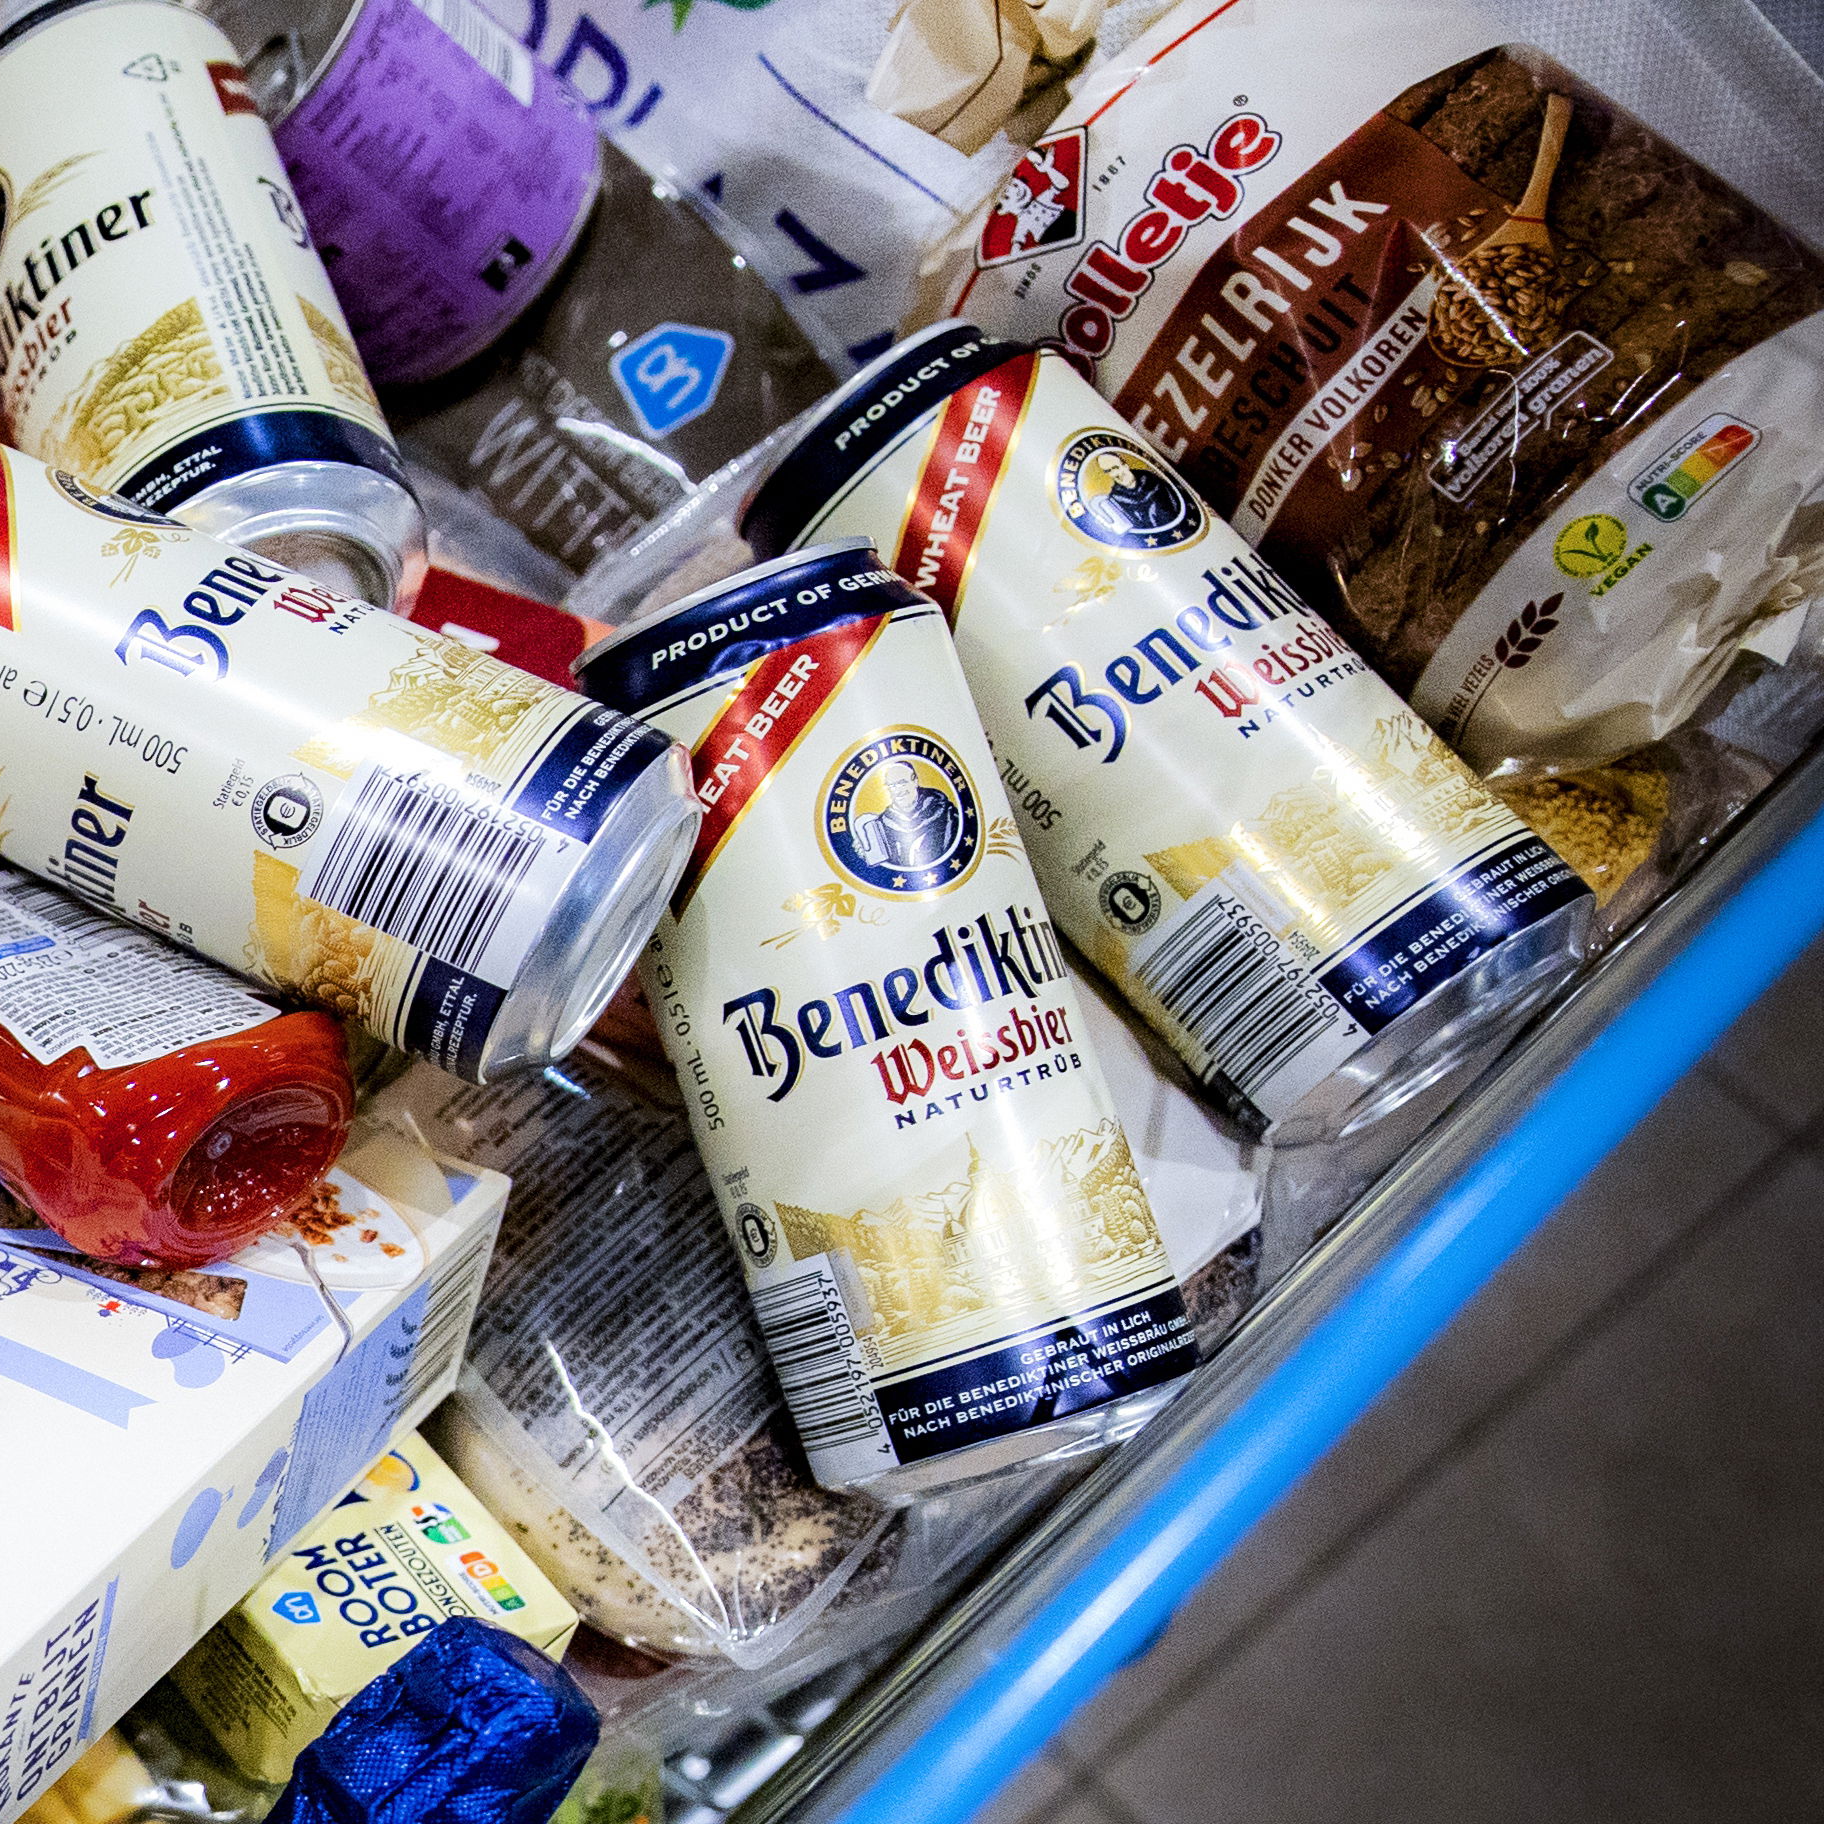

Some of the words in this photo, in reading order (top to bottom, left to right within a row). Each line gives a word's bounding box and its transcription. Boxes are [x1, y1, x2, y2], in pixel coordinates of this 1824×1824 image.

[1130, 180, 1391, 464] EZELRIJK
[832, 355, 953, 453] PRODUCT
[951, 339, 984, 363] OF
[1199, 272, 1374, 480] BESCHUIT
[1527, 346, 1604, 414] granen
[1250, 431, 1314, 520] DONKER
[1304, 304, 1428, 433] VOLKOREN
[913, 468, 975, 591] WHEAT
[958, 383, 1003, 466] BEER
[1636, 431, 1708, 492] NUTRI-SCORE
[1588, 542, 1655, 598] VEGAN
[650, 598, 790, 671] PRODUCT
[796, 583, 834, 607] OF
[1460, 654, 1496, 699] VEZELS
[57, 693, 95, 731] 0,5
[108, 713, 144, 751] mL
[699, 738, 751, 816] EAT
[743, 652, 822, 741] BEER
[141, 732, 189, 776] 500
[213, 757, 247, 810] Statiegeld
[828, 736, 968, 835] BENEDIKTINER
[540, 791, 568, 823] FÜR
[564, 778, 602, 821] NACH
[1022, 782, 1064, 834] 500
[1217, 894, 1282, 956] 005937
[439, 975, 466, 1018] ETTAL
[721, 902, 1070, 1104] Benediktin
[1274, 957, 1343, 1022] 052197
[1342, 977, 1377, 1005] FÜR
[1376, 948, 1410, 981] DIE
[1364, 975, 1413, 1011] NACH
[870, 1002, 1074, 1106] Weissbier
[1341, 1022, 1359, 1039] 4
[700, 1088, 725, 1132] 500
[893, 1050, 1083, 1131] NATURTRÜB
[818, 1275, 855, 1349] 005937
[1018, 1329, 1099, 1366] GEBRAUT
[1101, 1322, 1120, 1339] IN
[1121, 1310, 1152, 1335] LICH
[843, 1358, 884, 1430] 052197
[888, 1404, 922, 1427] FÜR
[924, 1398, 956, 1418] DIE
[957, 1352, 1090, 1405] BENEDIKTINER
[1093, 1326, 1168, 1361] WEISSBRÄU
[902, 1417, 951, 1441] NACH
[954, 1362, 1124, 1423] BENEDIKTINISCHER
[877, 1443, 892, 1456] 4
[291, 1543, 402, 1649] ROOM
[333, 1531, 441, 1637] BOTER
[379, 1523, 468, 1618] ONGEZOUTEN
[16, 1623, 72, 1802] ONTBIJT
[45, 1597, 101, 1770] GRANEN
